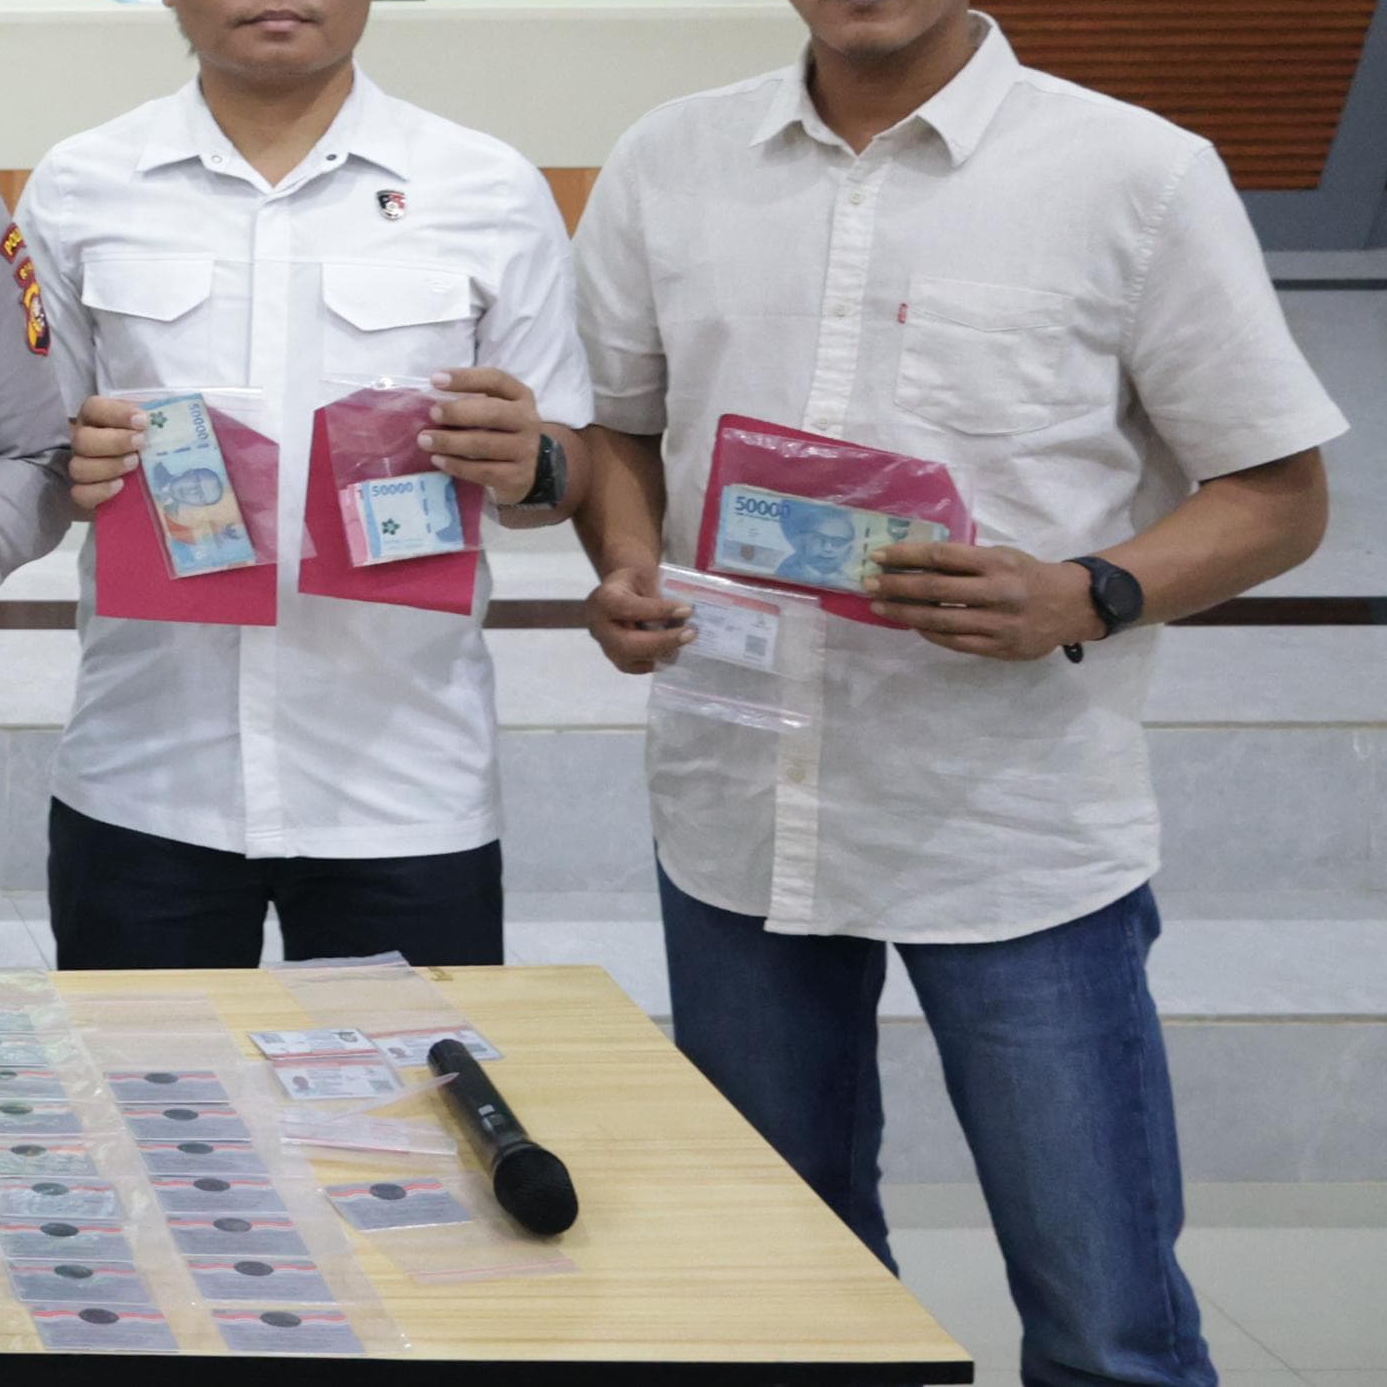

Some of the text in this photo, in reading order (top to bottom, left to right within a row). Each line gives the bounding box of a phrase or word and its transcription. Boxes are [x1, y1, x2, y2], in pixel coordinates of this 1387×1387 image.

[189, 402, 210, 441] 50000
[372, 481, 413, 497] 50000
[735, 495, 791, 519] 50000
